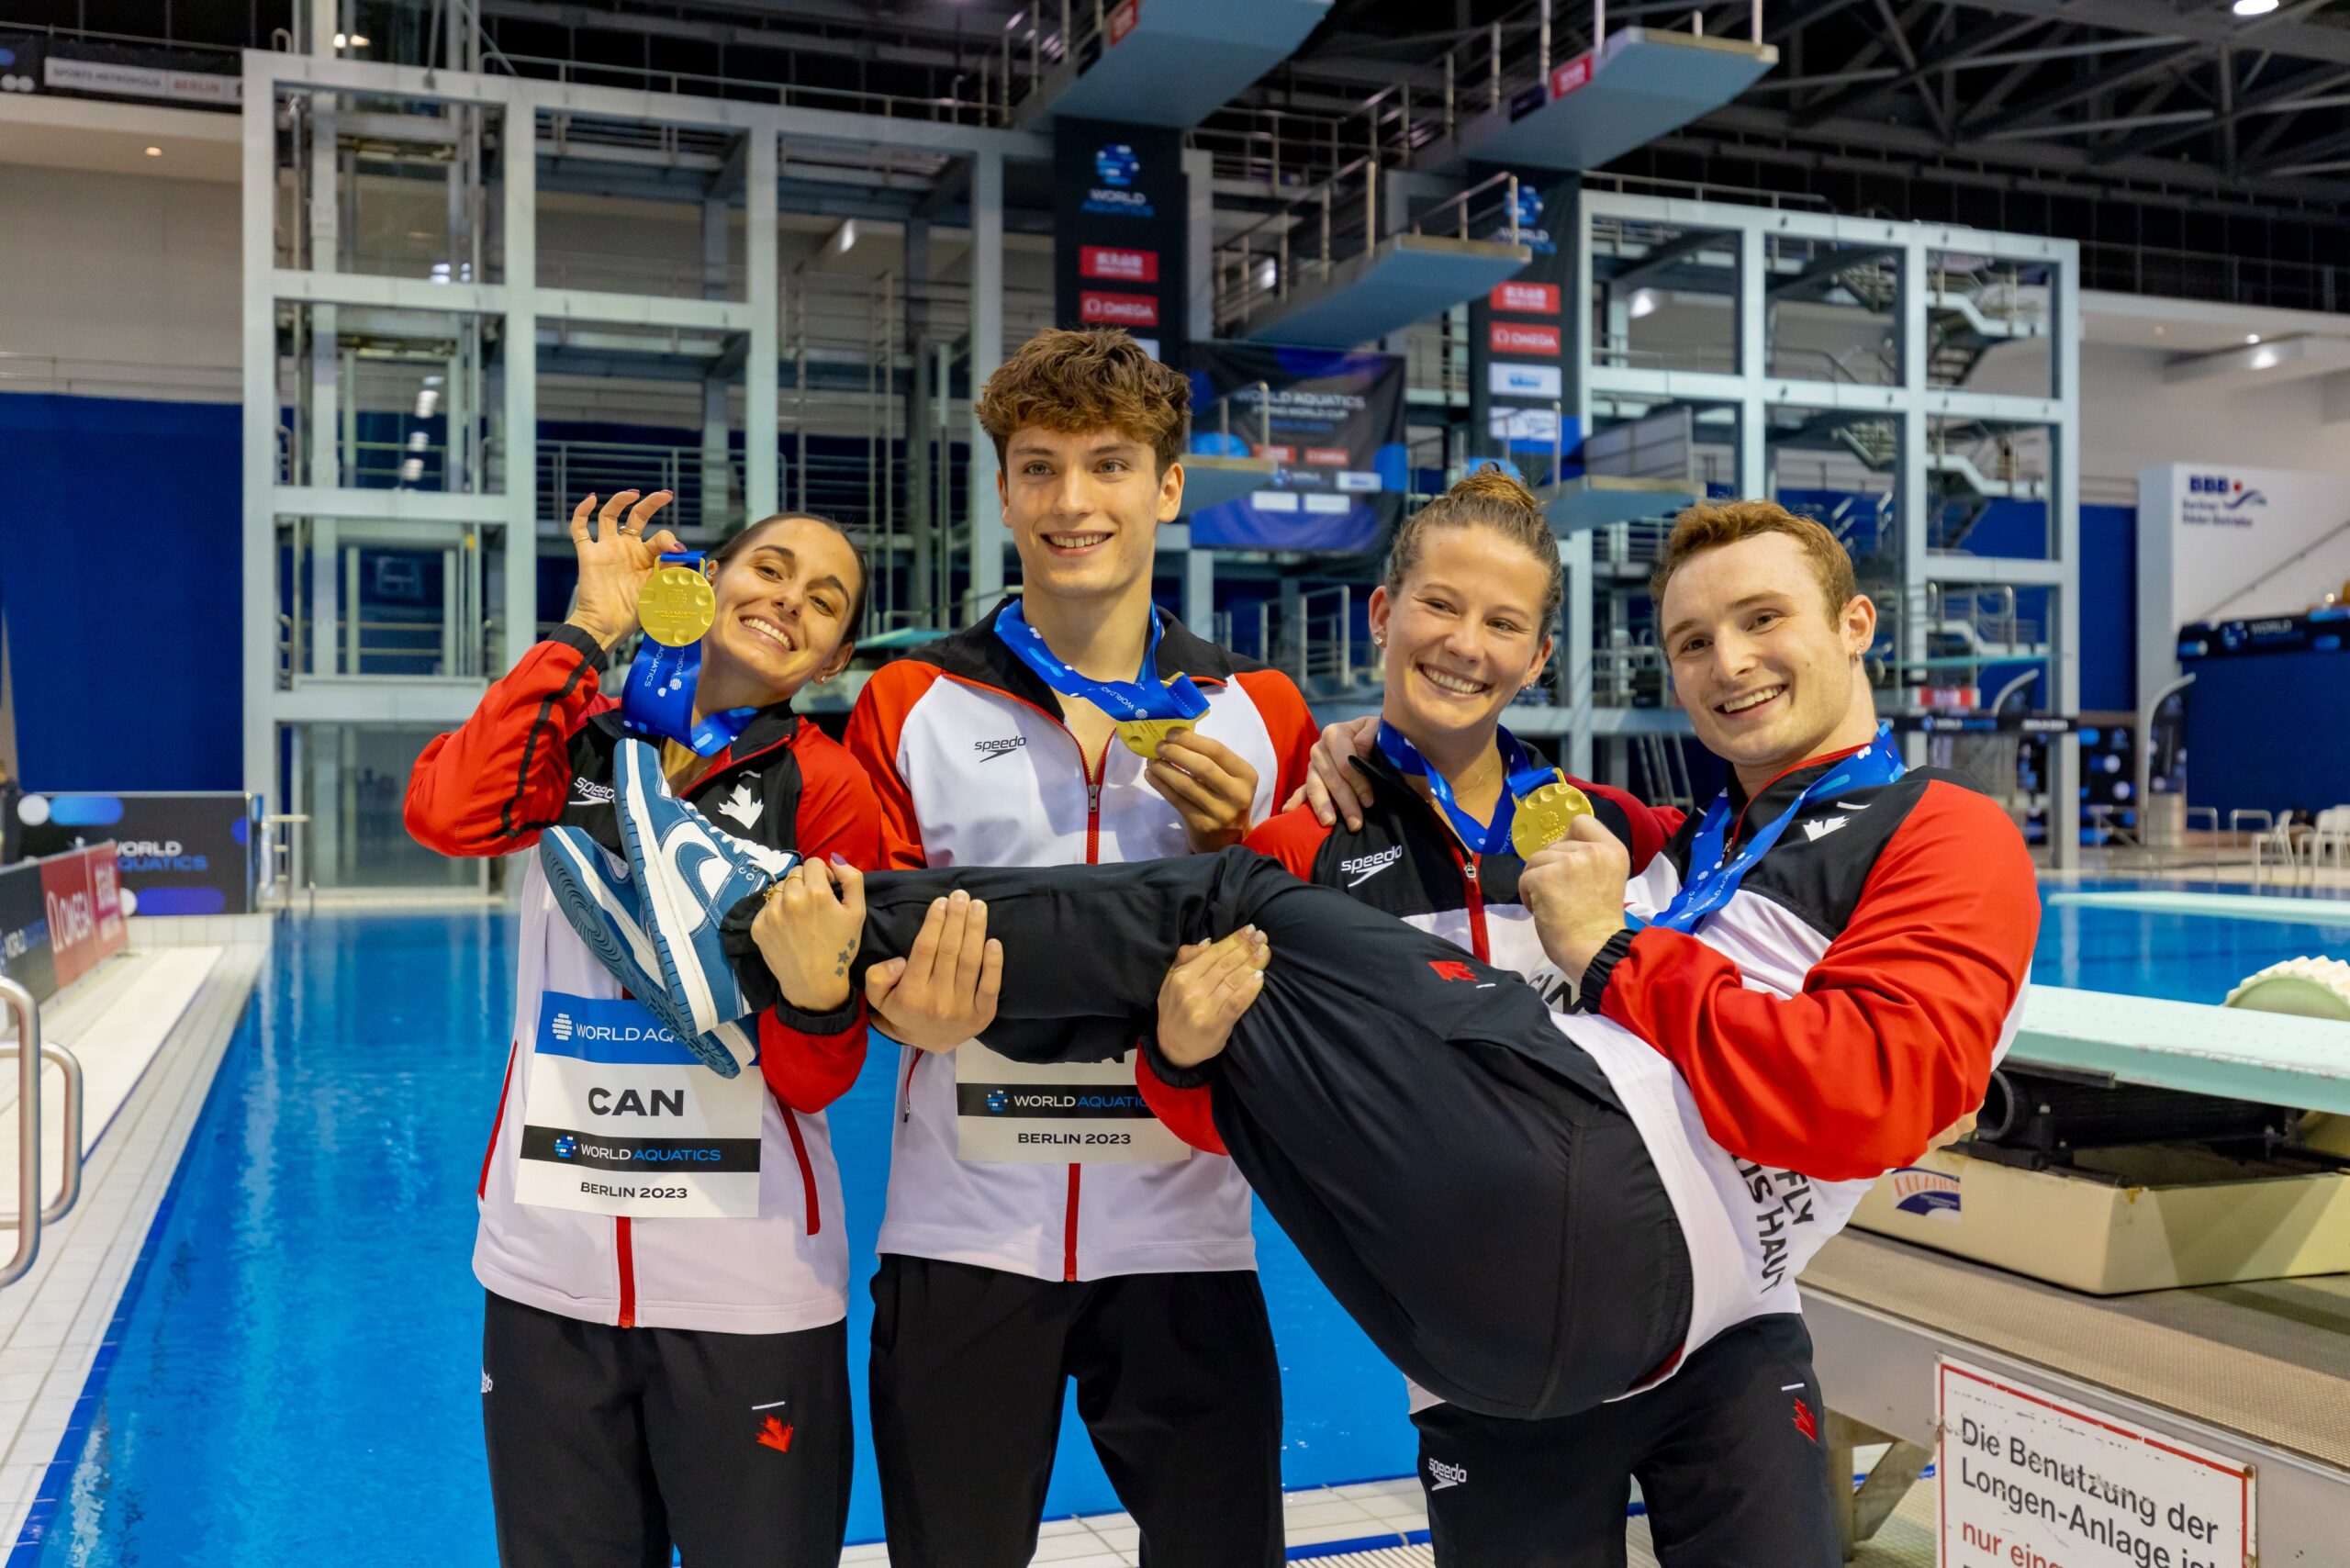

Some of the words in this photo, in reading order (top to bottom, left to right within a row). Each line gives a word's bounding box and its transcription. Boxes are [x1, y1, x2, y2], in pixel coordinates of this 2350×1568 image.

[1090, 189, 1146, 206] WORLD
[1104, 301, 1154, 319] OMEGA
[1293, 393, 1365, 410] AQUATICS
[2189, 476, 2229, 494] BBB
[2251, 620, 2292, 634] WORLD
[644, 645, 666, 688] AQUATICS
[974, 734, 1027, 752] speedo
[117, 841, 183, 857] ORLD
[118, 855, 207, 871] QUATICS
[1340, 845, 1403, 873] speedo
[576, 1023, 641, 1041] WORLD
[588, 1087, 685, 1116] CAN
[1013, 1095, 1076, 1108] WORLD
[1078, 1096, 1148, 1110] AQUATIC
[1017, 1132, 1081, 1145] BERLIN
[1085, 1133, 1131, 1145] 2023
[581, 1144, 632, 1160] WORLD
[632, 1149, 722, 1162] AQUATICS
[580, 1182, 635, 1198] BERLIN
[640, 1187, 688, 1199] 2023
[1428, 1457, 1467, 1483] speedo
[1962, 1417, 2000, 1456] Die
[2010, 1437, 2156, 1528] Benutzung
[2167, 1503, 2219, 1544] der
[1963, 1457, 2170, 1568] Longen-Anlage
[1962, 1521, 2003, 1556] nur
